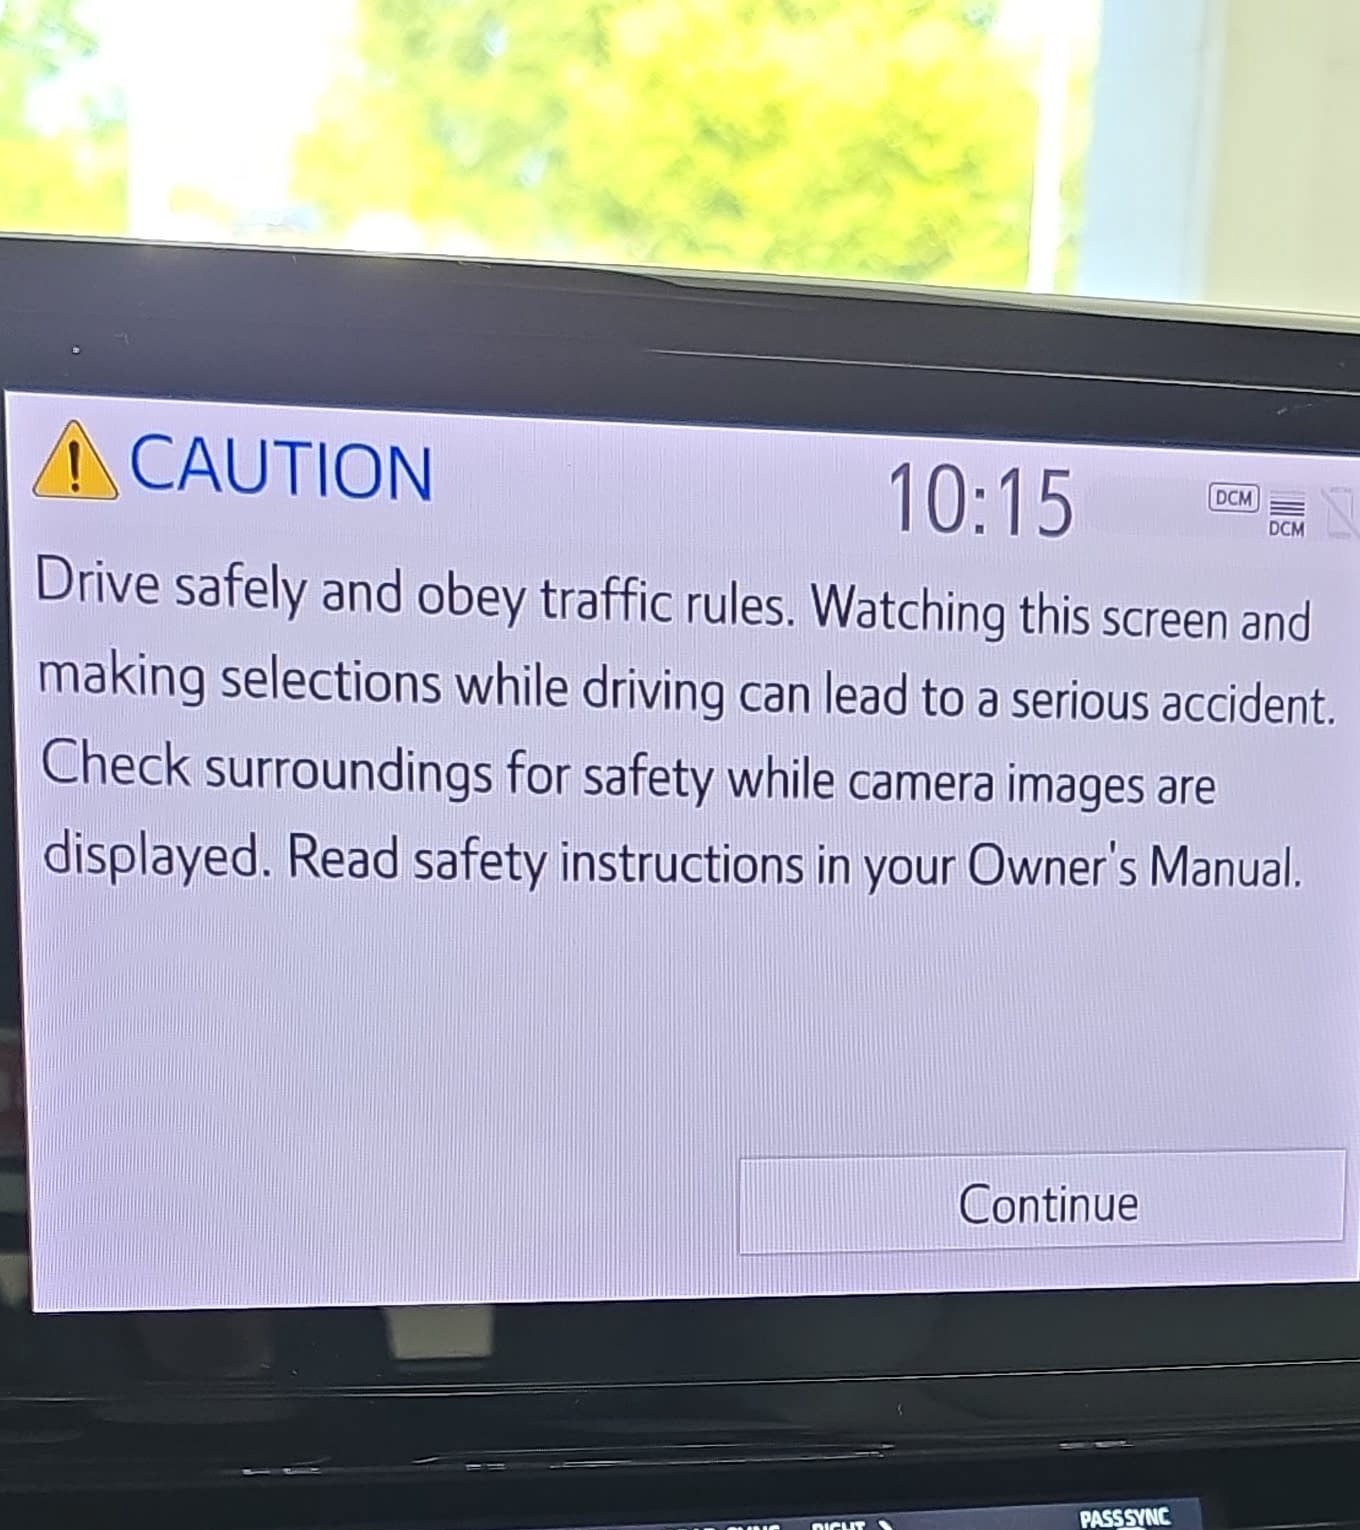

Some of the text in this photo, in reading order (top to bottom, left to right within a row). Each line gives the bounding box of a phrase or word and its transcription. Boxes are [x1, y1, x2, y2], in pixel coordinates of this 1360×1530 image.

[131, 433, 432, 502] CAUTION
[889, 462, 1074, 538] 10:15
[1216, 489, 1252, 507] DCM
[1270, 521, 1305, 537] DCM
[37, 553, 1310, 642] Drive safely and obey traffic rules. Watching this screen and
[39, 648, 1336, 726] making selections while driving can lead to a serious accident.
[43, 738, 1216, 813] Check surroundings for safety while camera images are
[44, 830, 1302, 895] displayed. Read safety instructions in your Owner's Manual.
[959, 1183, 1138, 1226] Continue
[1080, 1507, 1171, 1528] PASS SYNC
